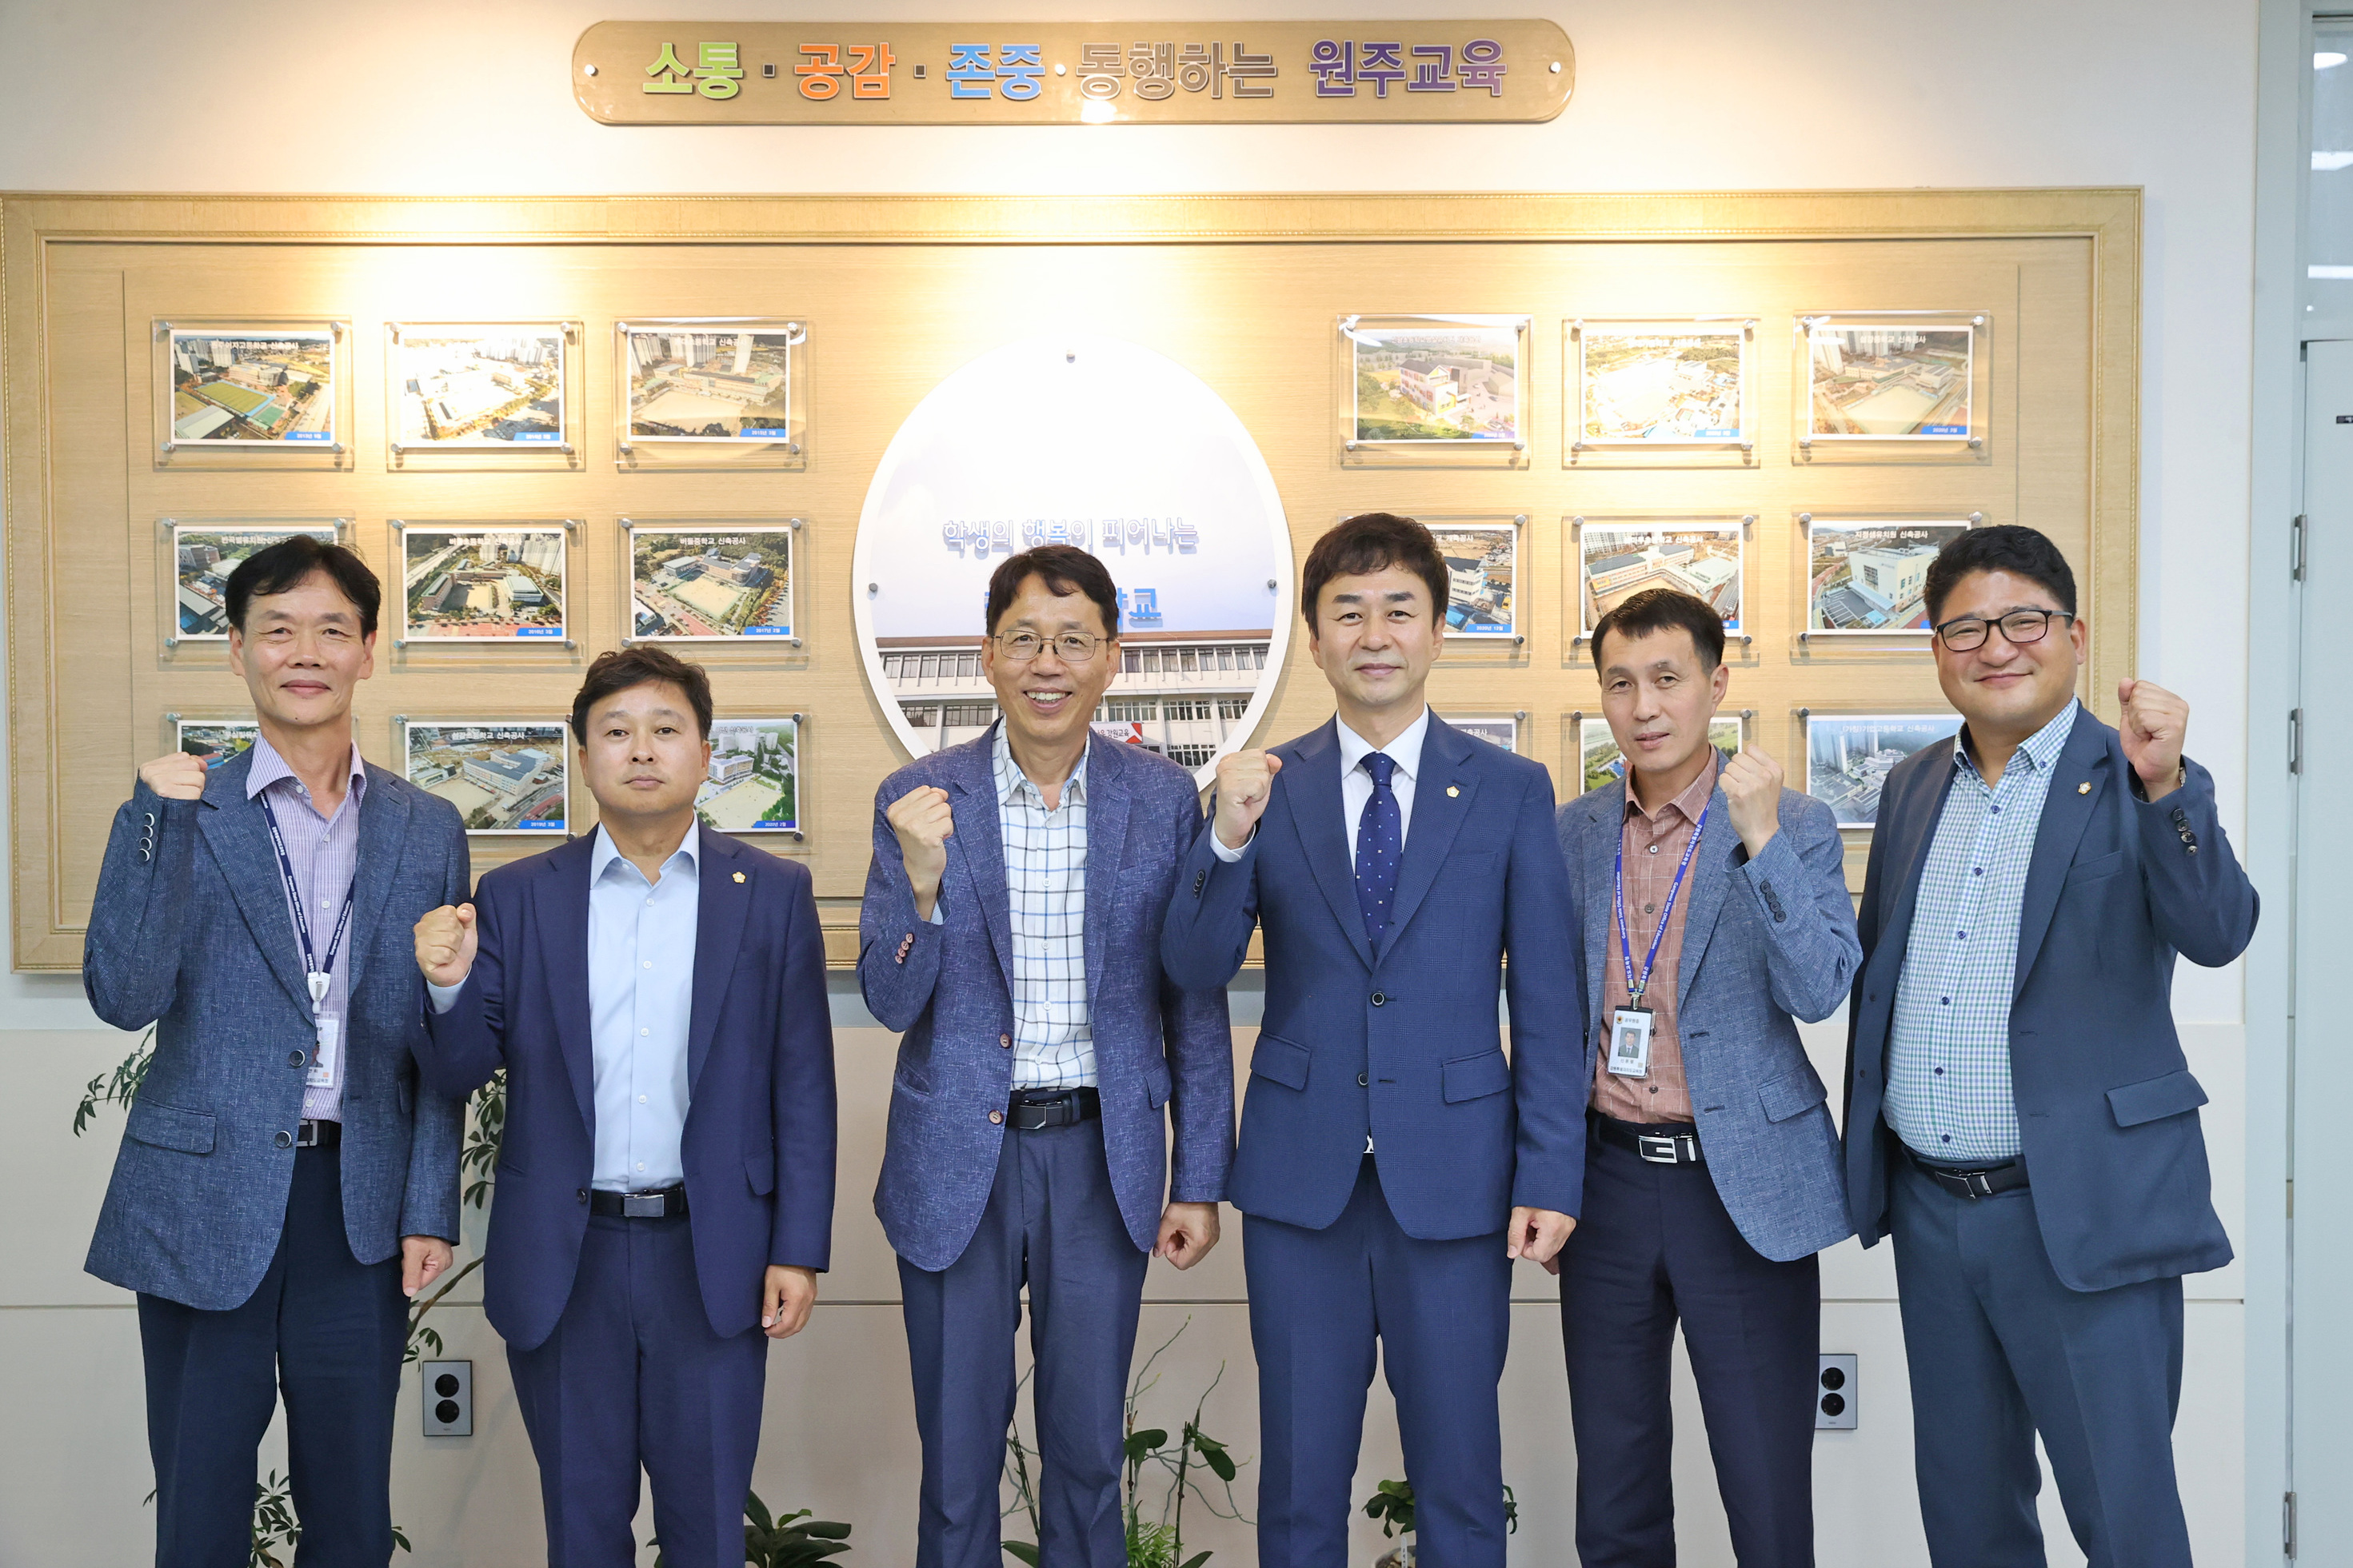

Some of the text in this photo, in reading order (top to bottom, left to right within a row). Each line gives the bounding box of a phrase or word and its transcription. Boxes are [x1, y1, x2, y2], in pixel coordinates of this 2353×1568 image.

[642, 38, 1508, 100] 소통 공감 존중 동행하는 원주교육
[718, 537, 746, 545] 신축공사
[942, 517, 1198, 551] 학생의 행복이 피어나는
[1900, 530, 1928, 539] 신축공사
[497, 731, 525, 740] 신축공사
[1907, 724, 1935, 733] 신축공사
[1668, 881, 1679, 902] Gangwon
[1651, 929, 1662, 950] Education
